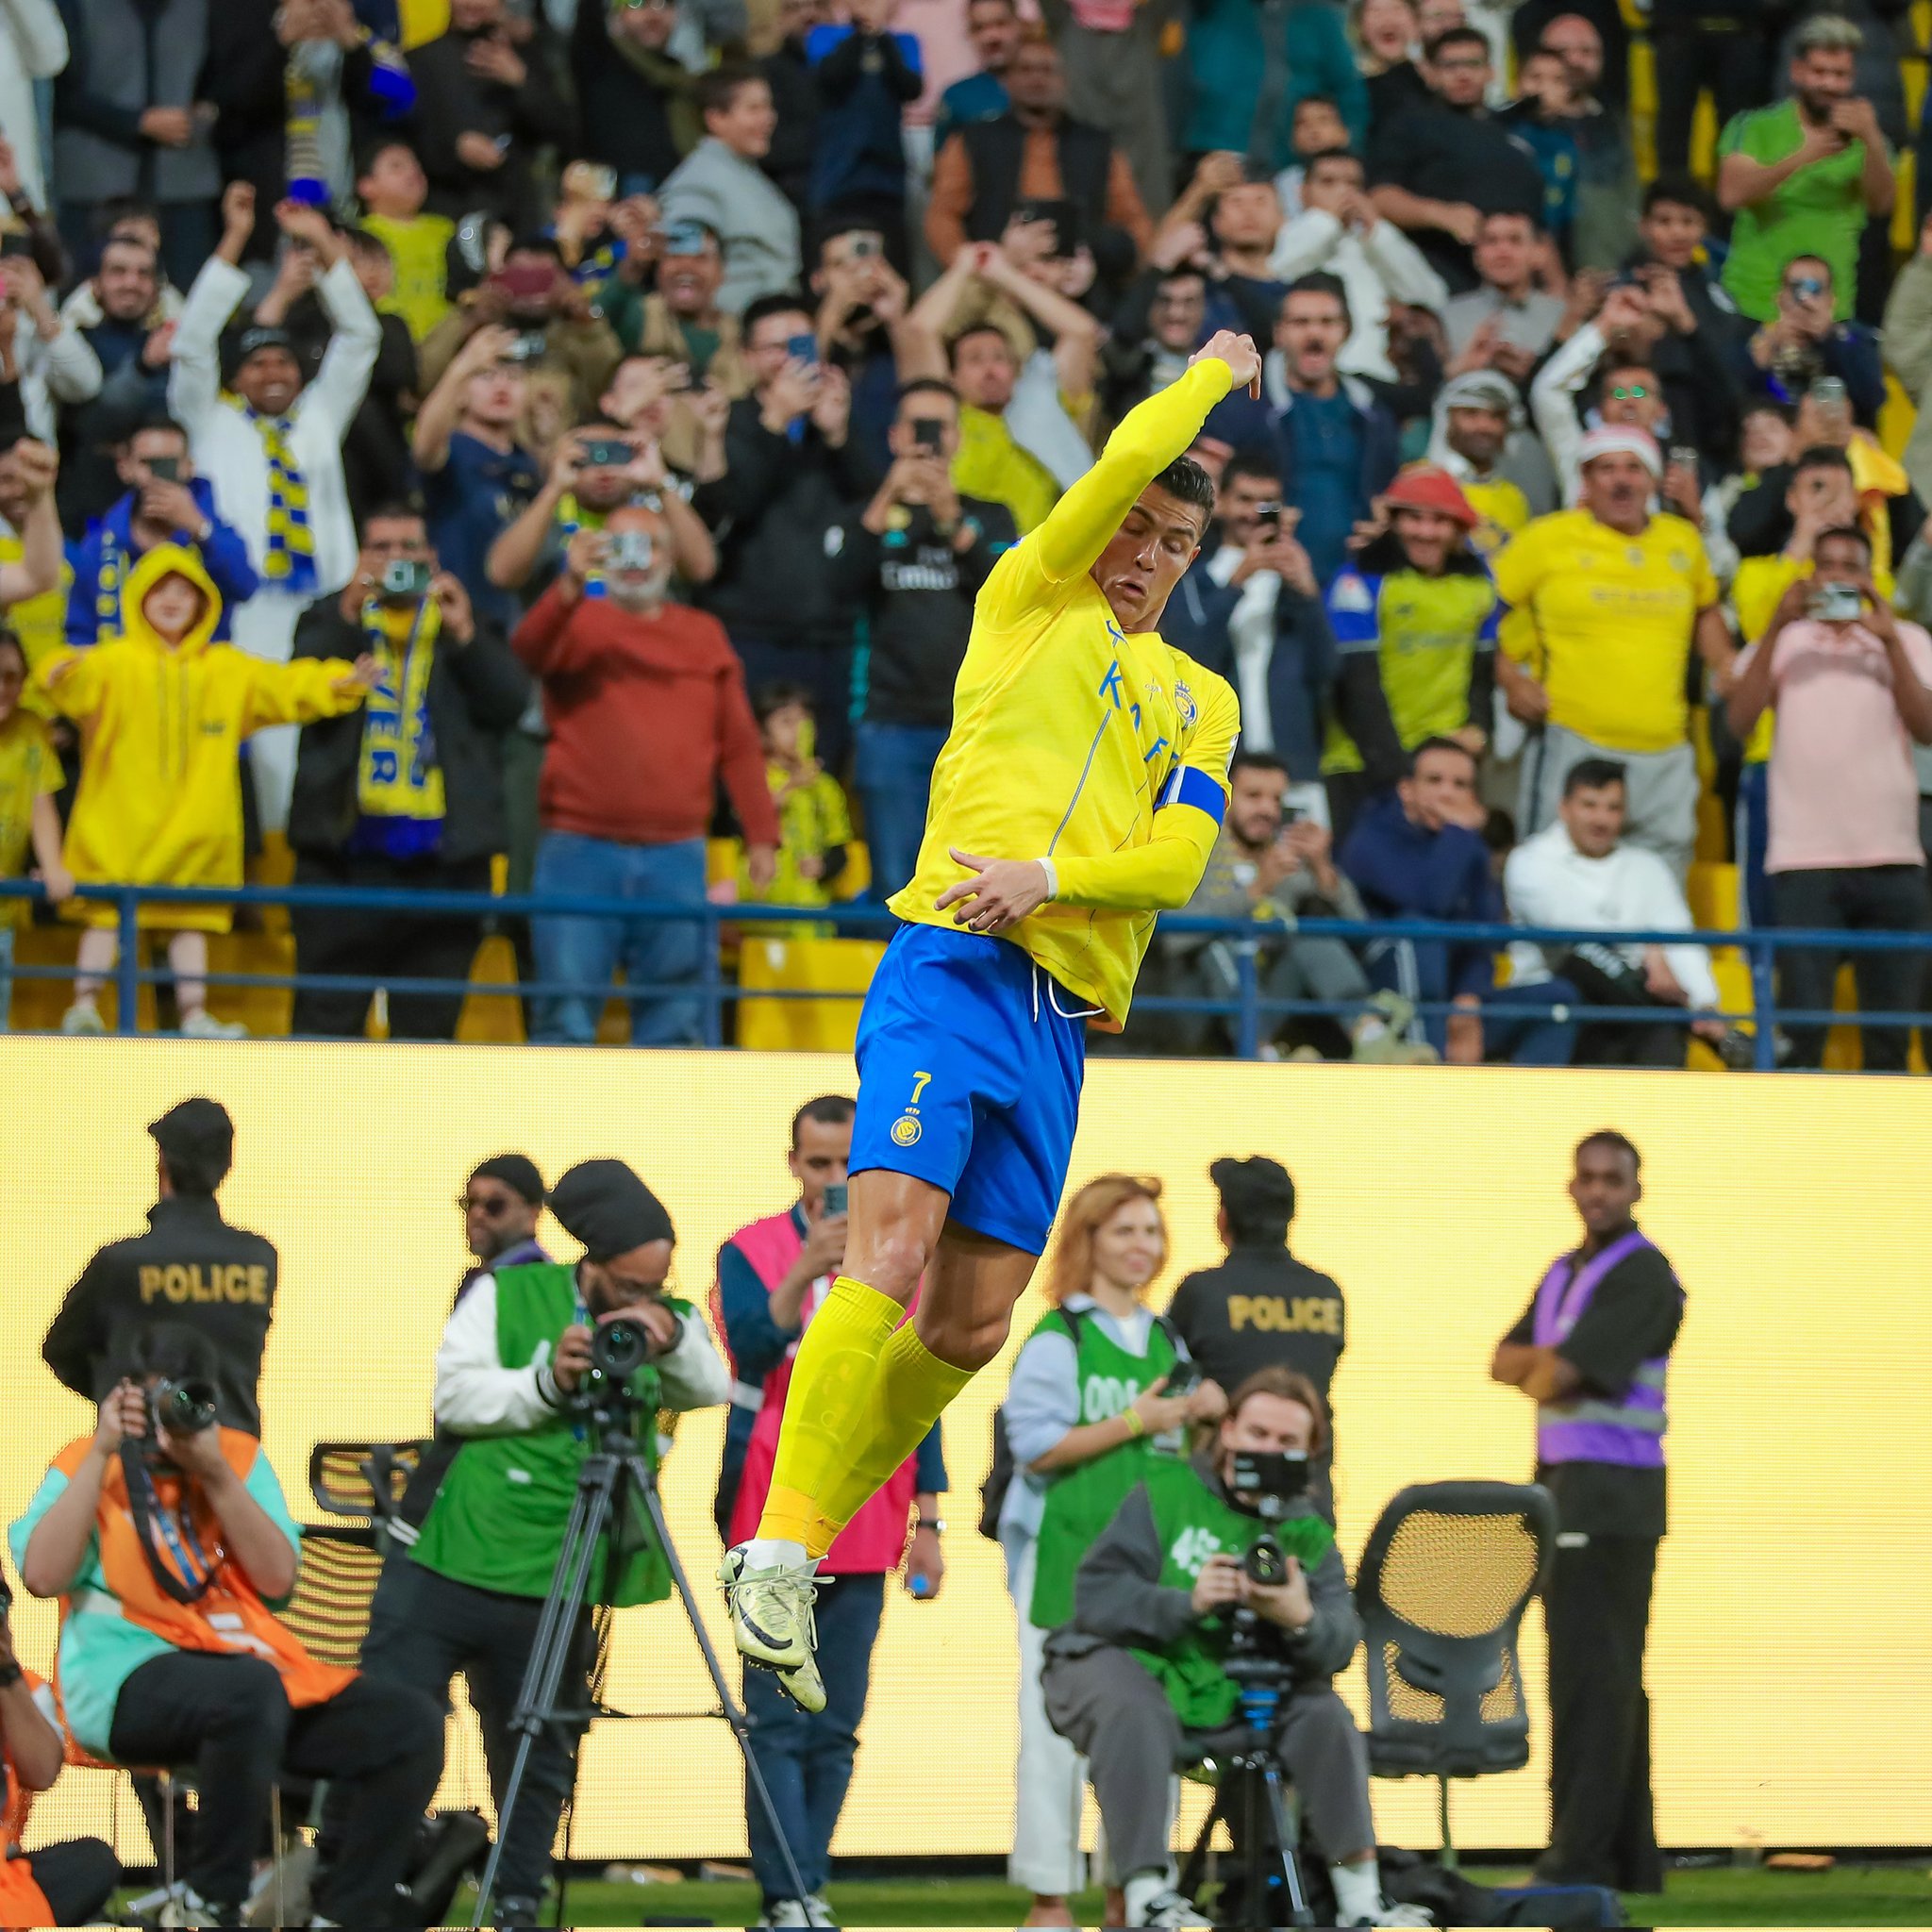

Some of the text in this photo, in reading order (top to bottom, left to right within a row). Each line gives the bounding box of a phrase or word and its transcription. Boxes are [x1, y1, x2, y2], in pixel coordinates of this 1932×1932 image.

[910, 1071, 931, 1104] 7
[139, 1263, 269, 1306] POLICE
[1228, 1294, 1341, 1335] POLICE
